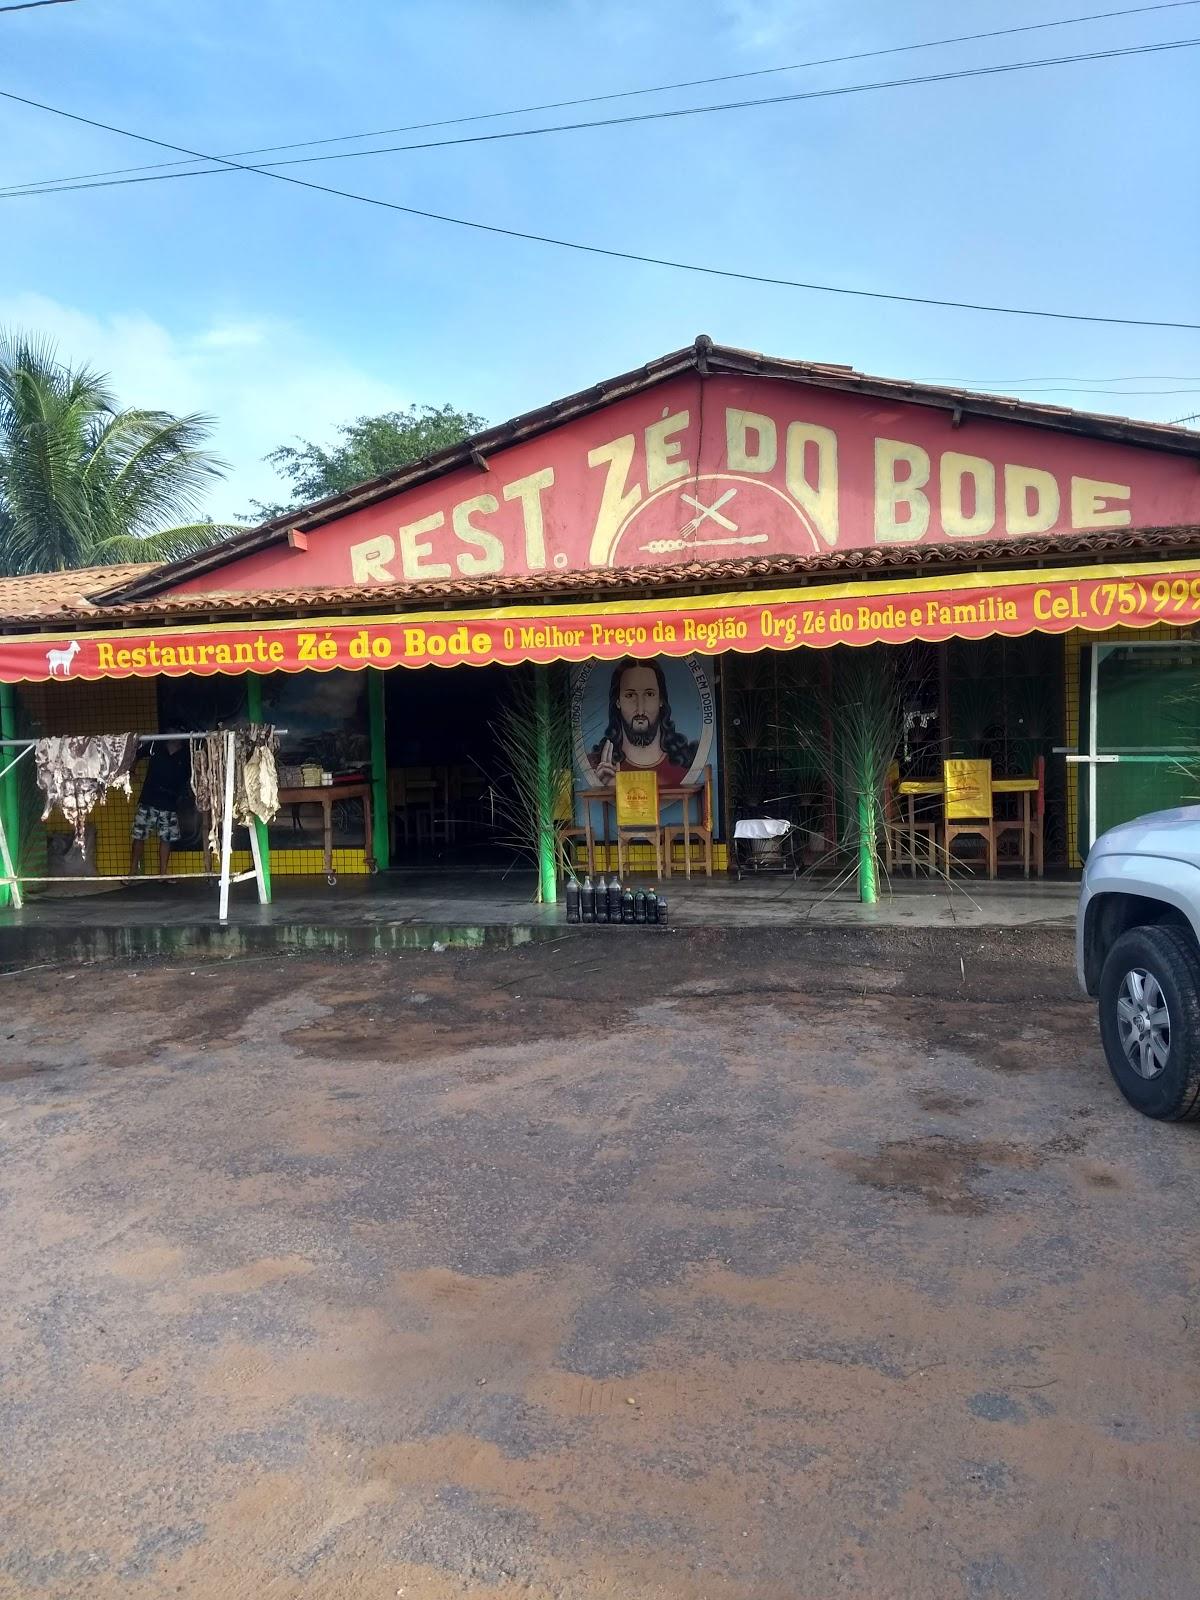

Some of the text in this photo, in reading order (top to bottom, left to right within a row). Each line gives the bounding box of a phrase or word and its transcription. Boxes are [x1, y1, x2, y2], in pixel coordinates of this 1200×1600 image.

[350, 407, 1131, 583] REST. ZÉ DO BODE
[96, 635, 285, 671] Restaurante
[297, 632, 338, 661] Zé
[349, 631, 392, 659] do
[403, 626, 493, 657] Bode
[504, 627, 514, 650] O
[520, 625, 585, 650] Melhor
[591, 623, 646, 648] Preço
[653, 620, 676, 643] da
[683, 616, 747, 649] Região
[829, 608, 854, 632] do
[857, 604, 907, 631] Bode
[910, 608, 922, 624] e
[926, 597, 1018, 626] Família
[1033, 586, 1087, 620] Cel.
[688, 659, 713, 725] DE EM DOBRO
